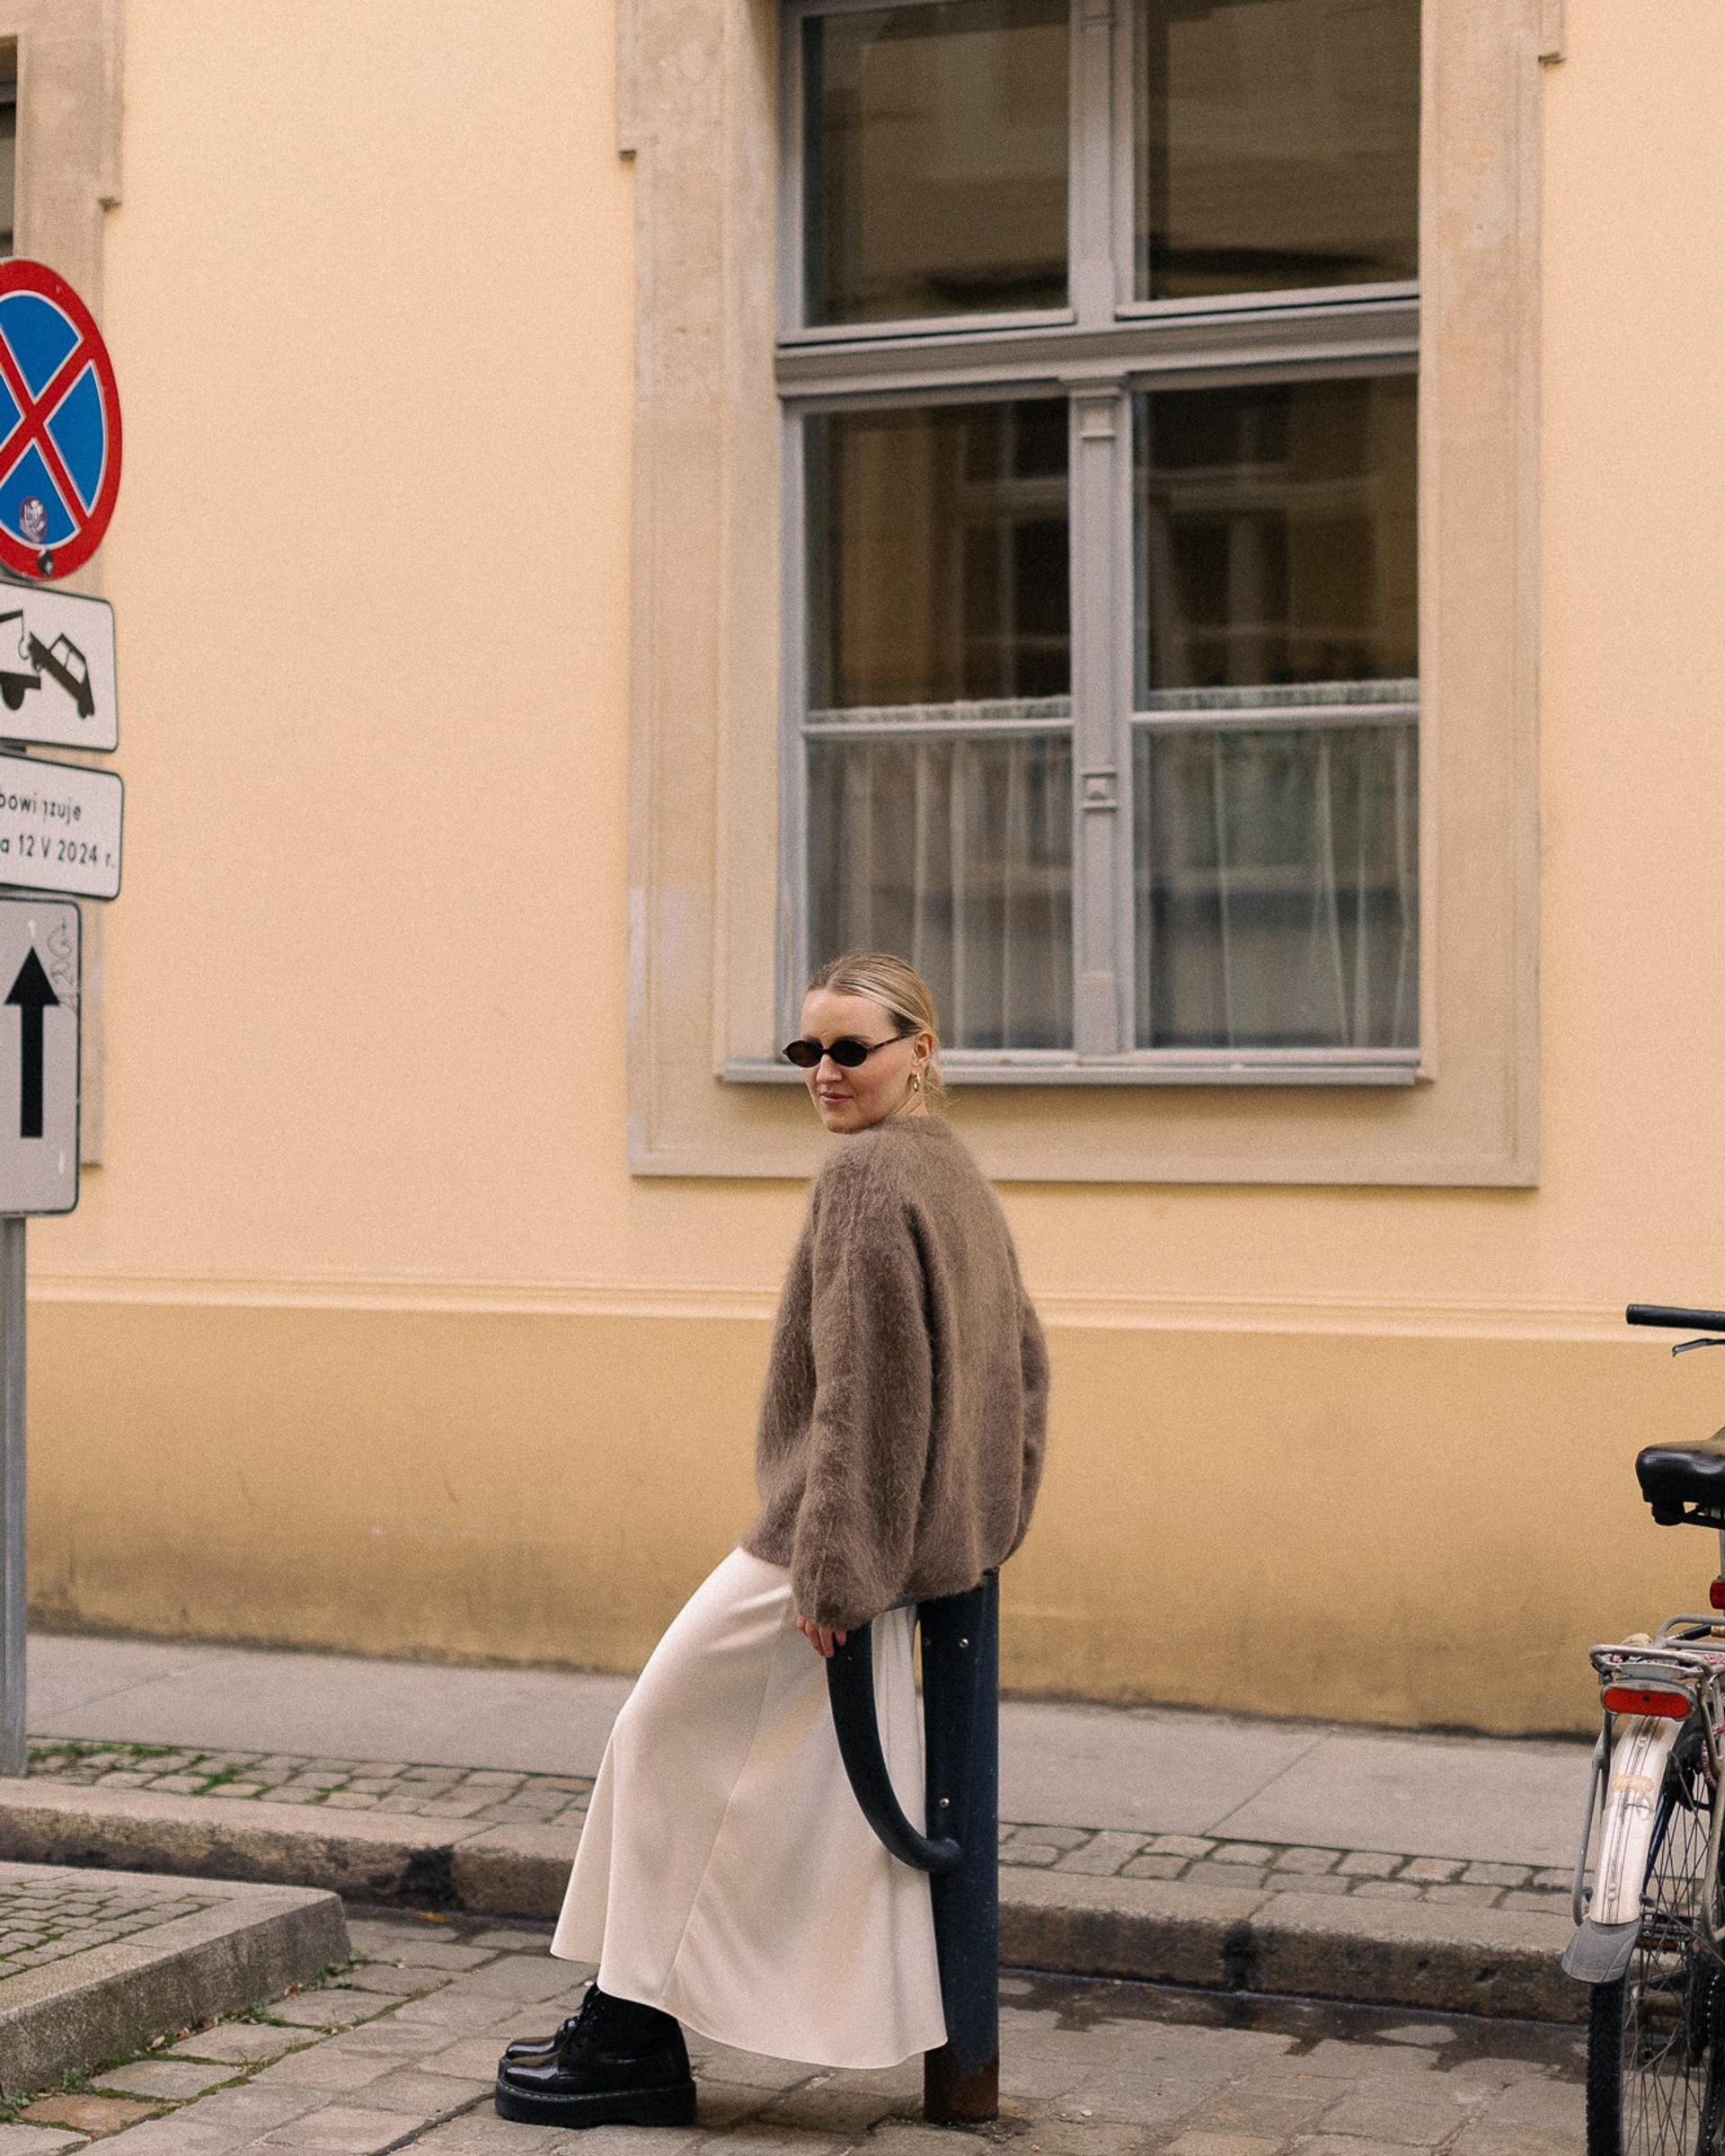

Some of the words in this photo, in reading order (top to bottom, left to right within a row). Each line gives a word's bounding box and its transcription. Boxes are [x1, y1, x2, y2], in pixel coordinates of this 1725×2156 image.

[19, 834, 34, 857] 12
[41, 836, 50, 859] V
[58, 839, 97, 864] 2024
